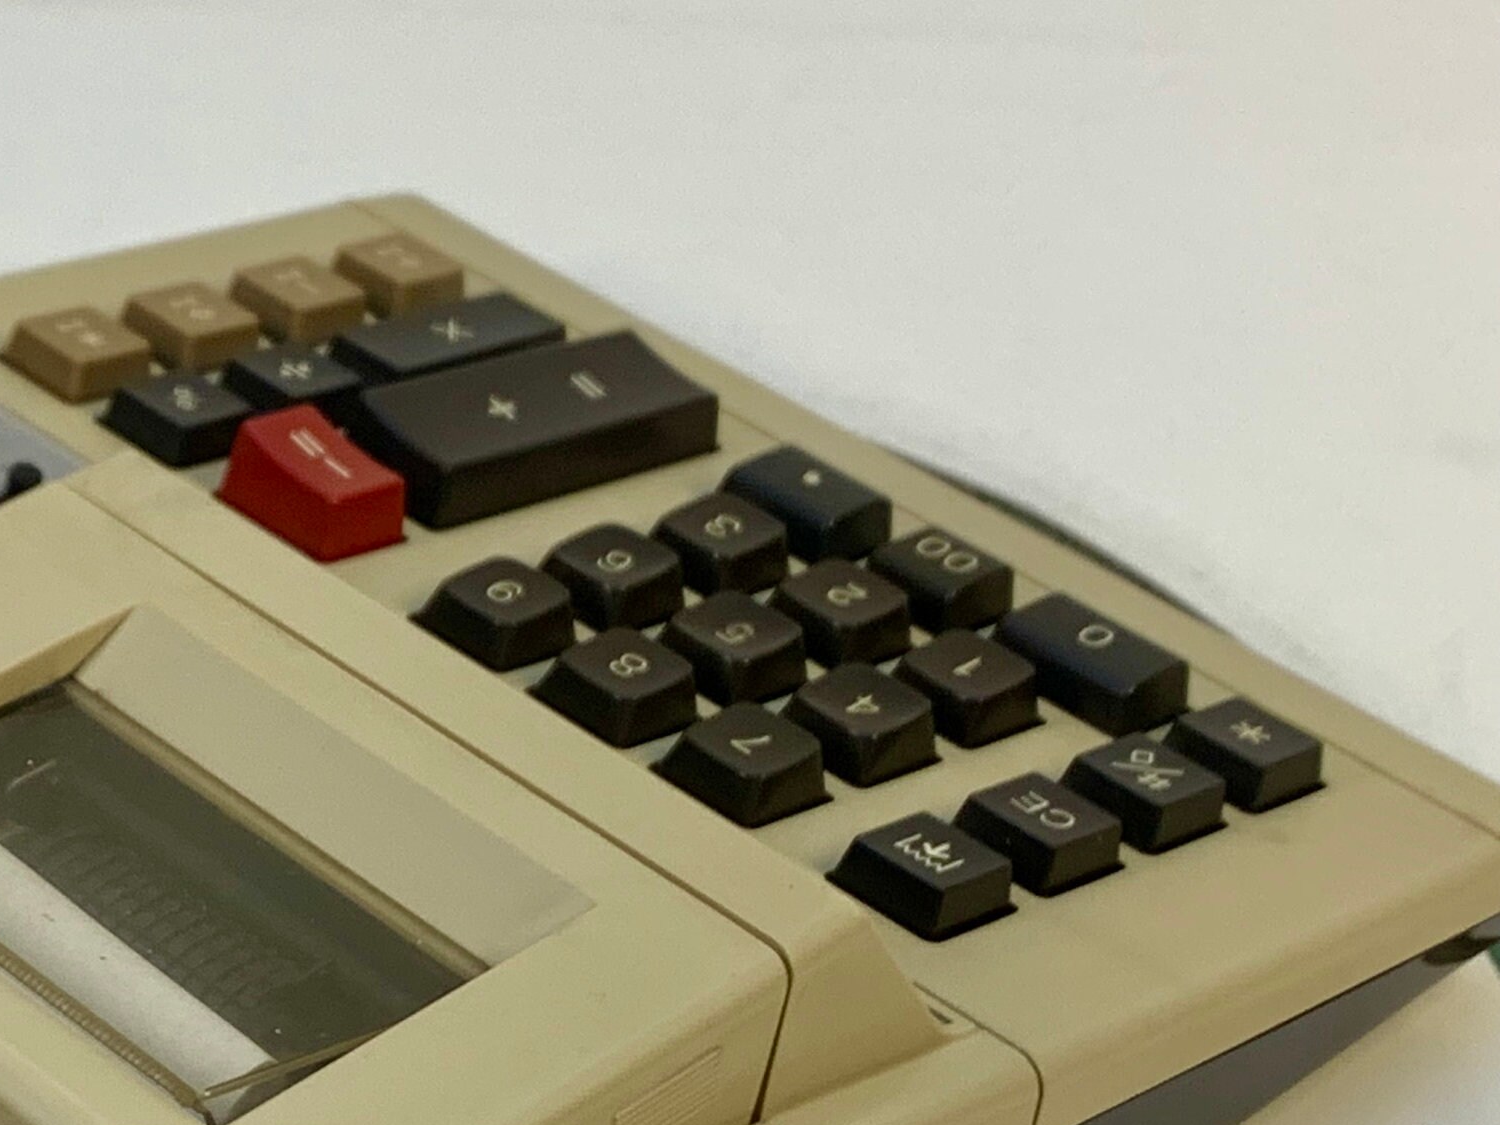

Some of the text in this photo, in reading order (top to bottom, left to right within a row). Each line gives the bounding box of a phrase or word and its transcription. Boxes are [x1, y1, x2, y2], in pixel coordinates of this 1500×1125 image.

[704, 513, 742, 540] 3
[596, 548, 633, 573] 6
[916, 535, 979, 574] 00
[485, 579, 524, 604] 9
[826, 581, 868, 608] 2
[714, 622, 756, 645] 5
[1078, 624, 1115, 649] 0
[608, 652, 648, 678] 8
[952, 655, 984, 679] 1
[844, 692, 882, 715] 4
[729, 733, 773, 756] 7
[1010, 789, 1077, 831] CE
